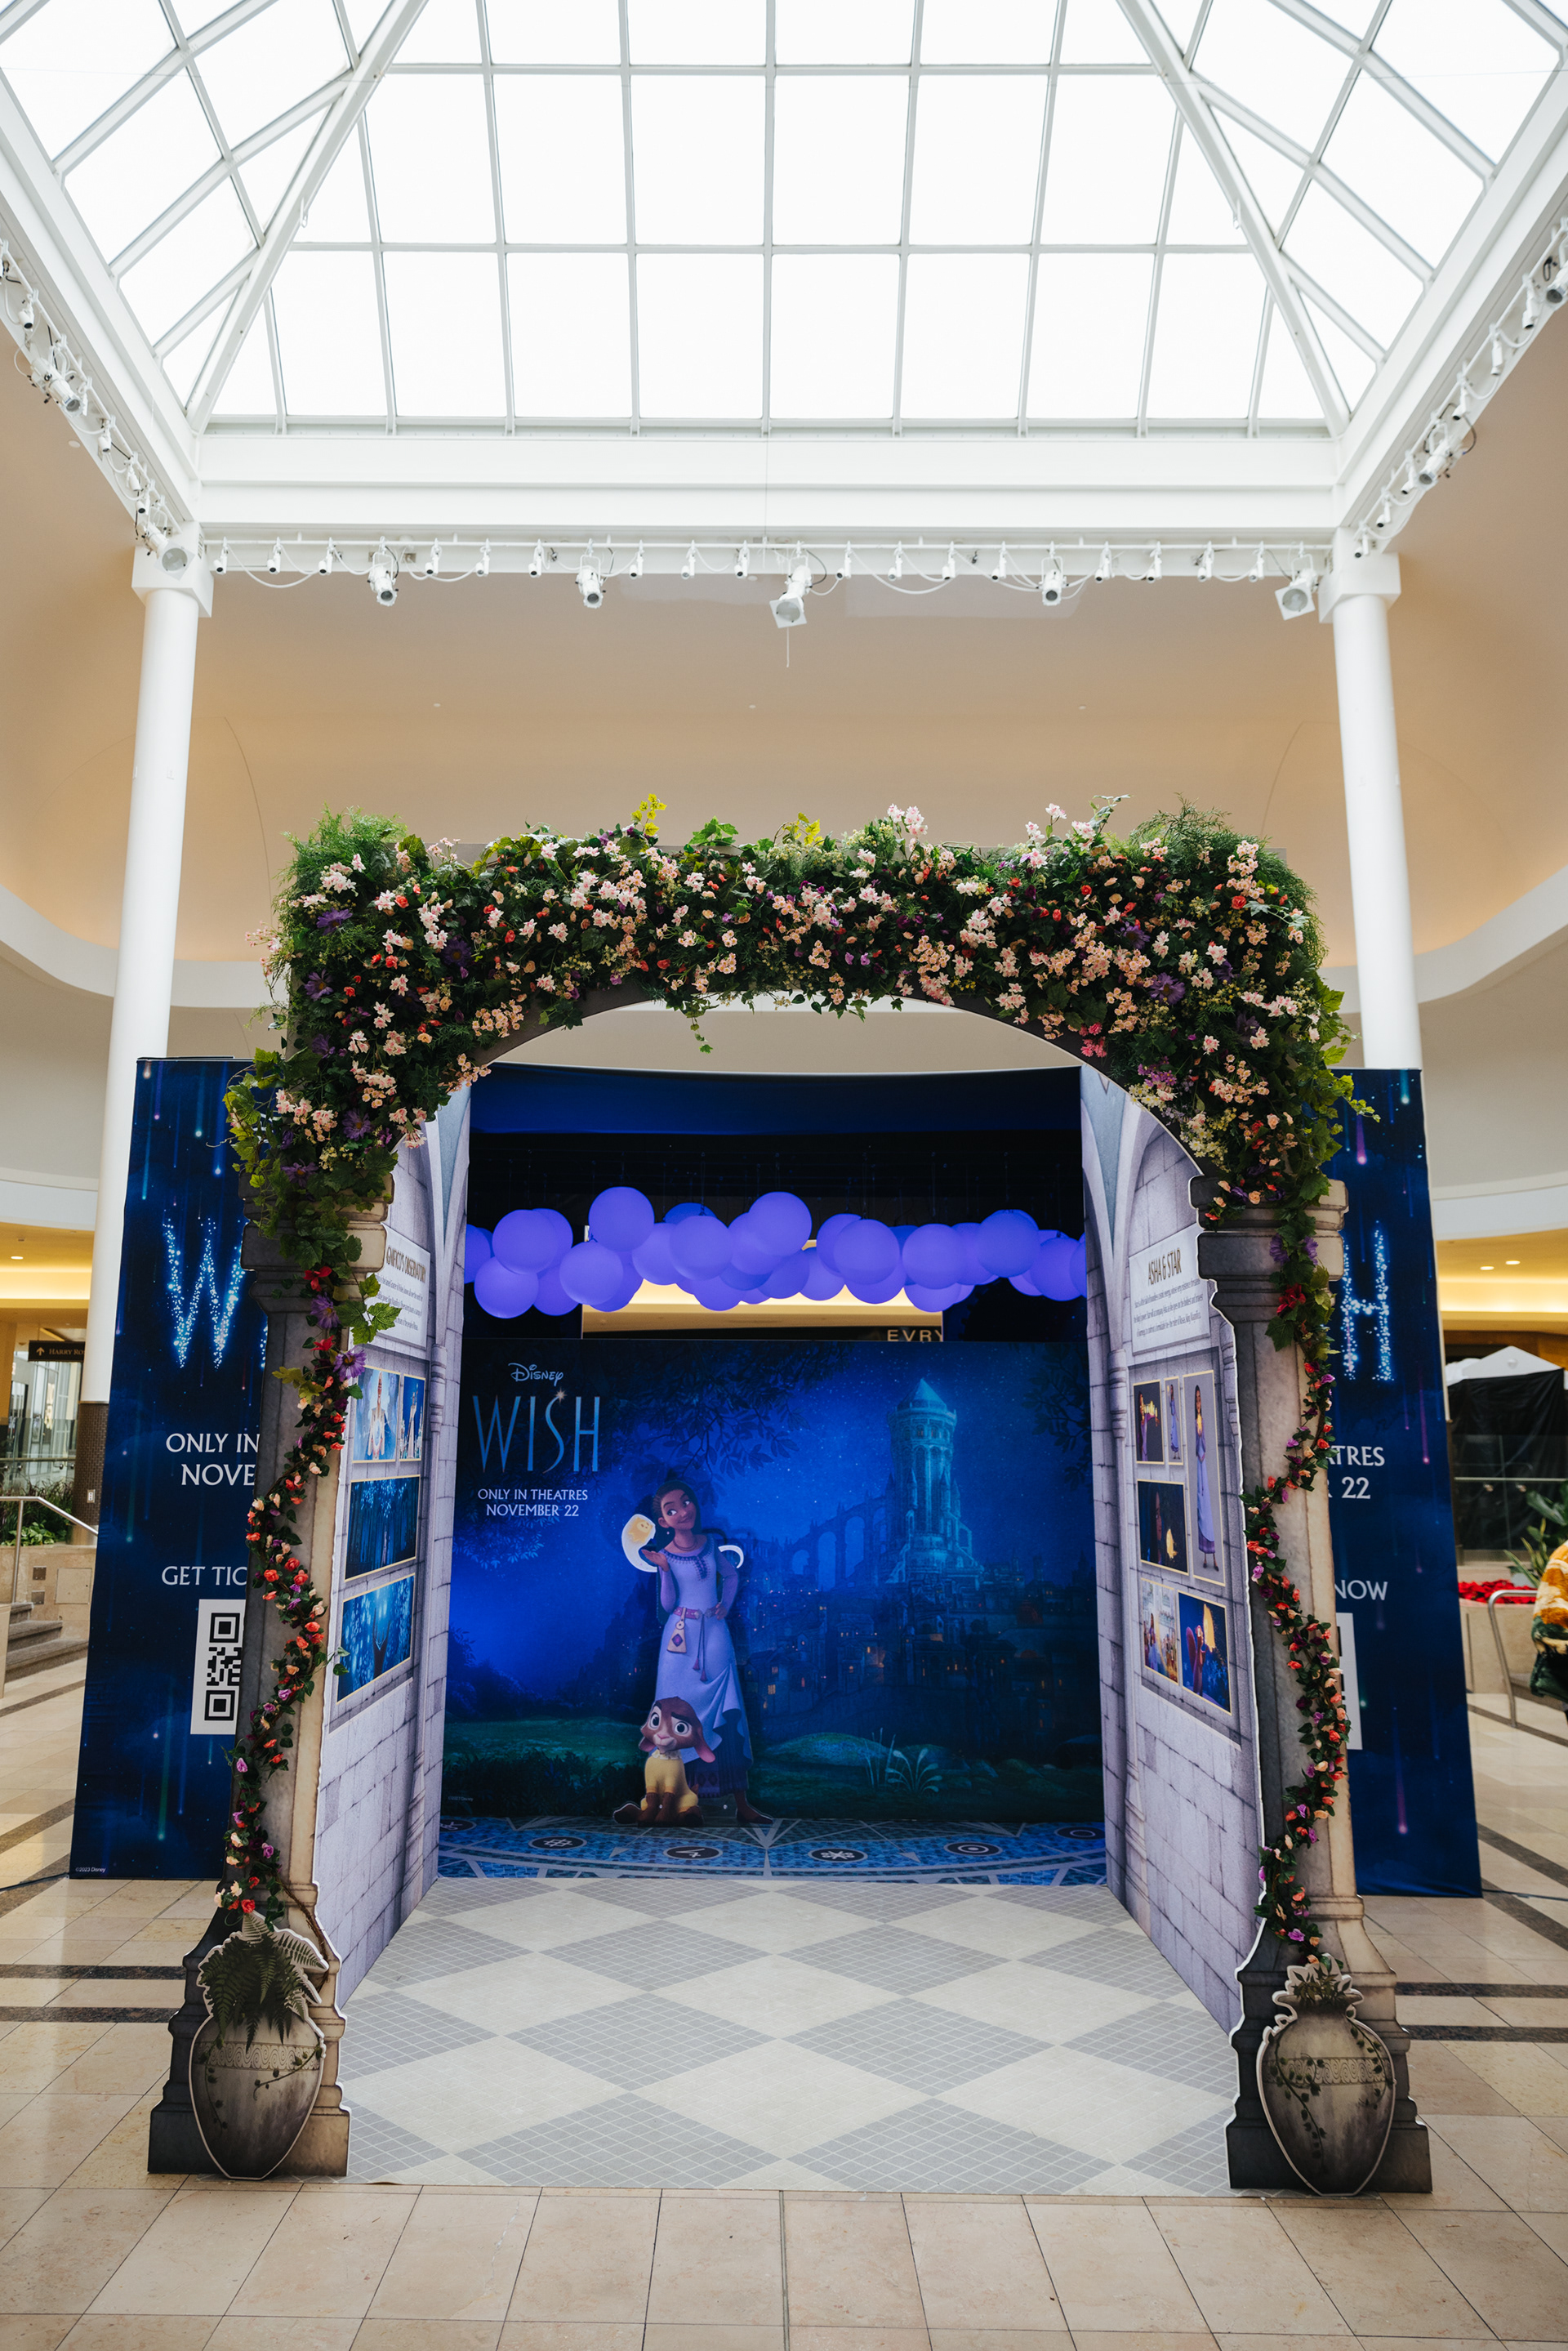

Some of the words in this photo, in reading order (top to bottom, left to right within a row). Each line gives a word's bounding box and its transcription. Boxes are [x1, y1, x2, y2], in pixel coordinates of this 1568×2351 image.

[386, 1245, 405, 1272] GNIFICO'S
[1148, 1258, 1162, 1286] ASHA
[1161, 1255, 1166, 1280] &
[1167, 1247, 1182, 1278] STAR
[508, 1363, 564, 1386] Disney
[472, 1388, 600, 1474] WISH
[166, 1433, 229, 1453] ONLY
[236, 1434, 261, 1453] IN
[478, 1488, 510, 1500] ONLY
[514, 1489, 528, 1500] IN
[531, 1489, 588, 1501] THEATRES
[1341, 1476, 1371, 1499] 22
[486, 1504, 559, 1516] NOVEMBER
[564, 1505, 579, 1517] 22
[162, 1566, 206, 1586] GET
